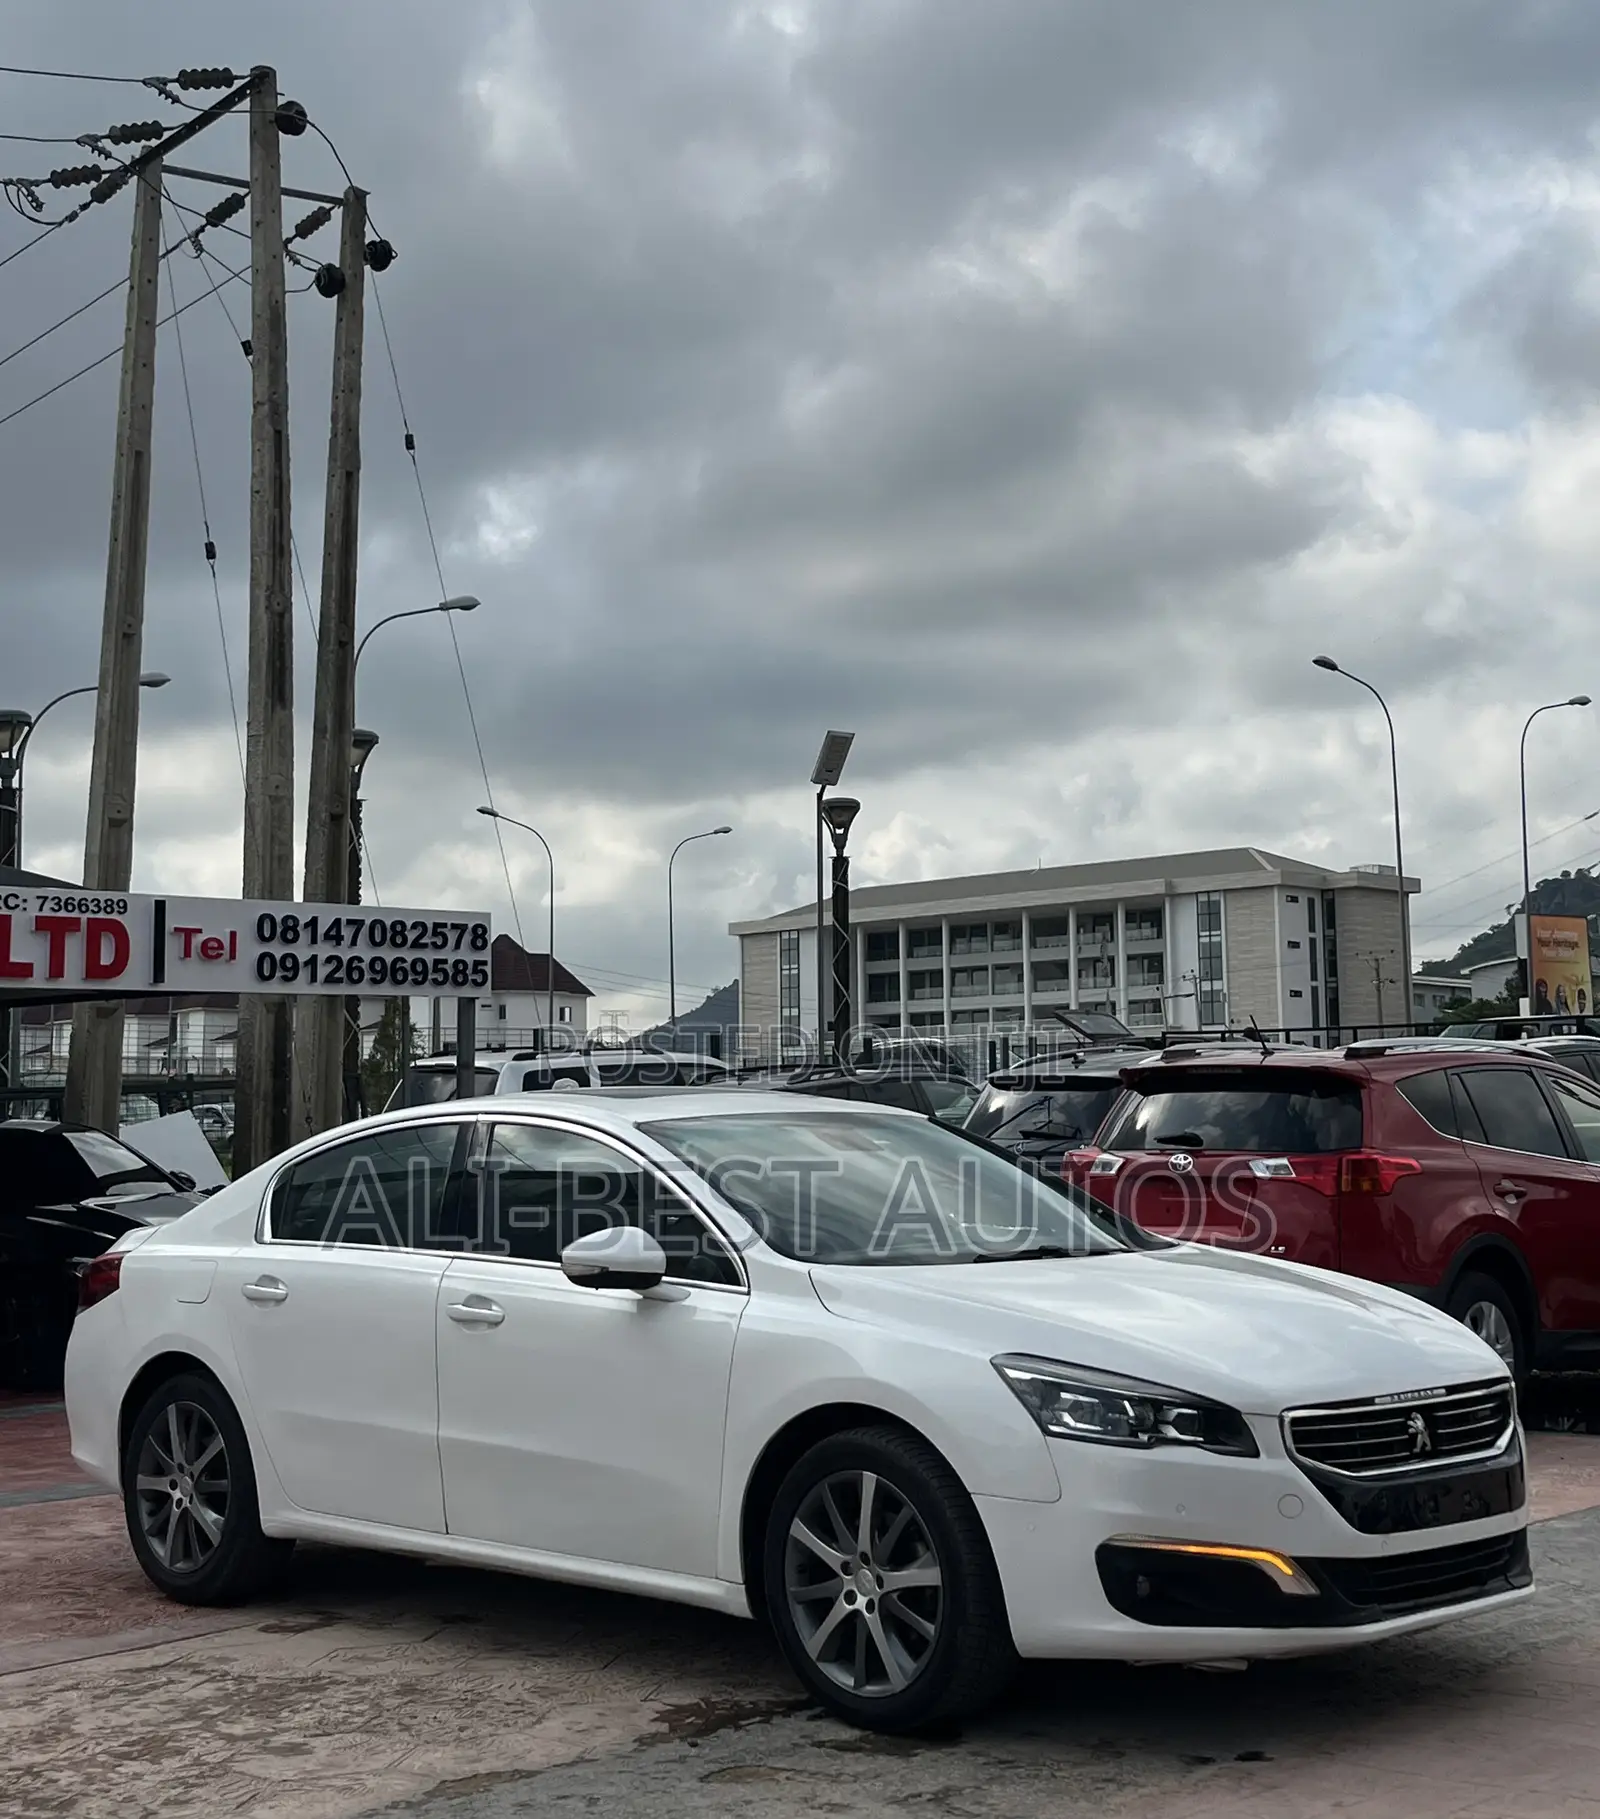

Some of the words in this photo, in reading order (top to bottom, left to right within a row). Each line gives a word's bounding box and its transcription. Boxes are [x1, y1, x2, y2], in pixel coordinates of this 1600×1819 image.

[36, 896, 128, 914] 7366389
[0, 914, 130, 980] LTD
[173, 927, 237, 961] Tel
[256, 913, 488, 951] 08147082578
[256, 951, 488, 986] 09126969585
